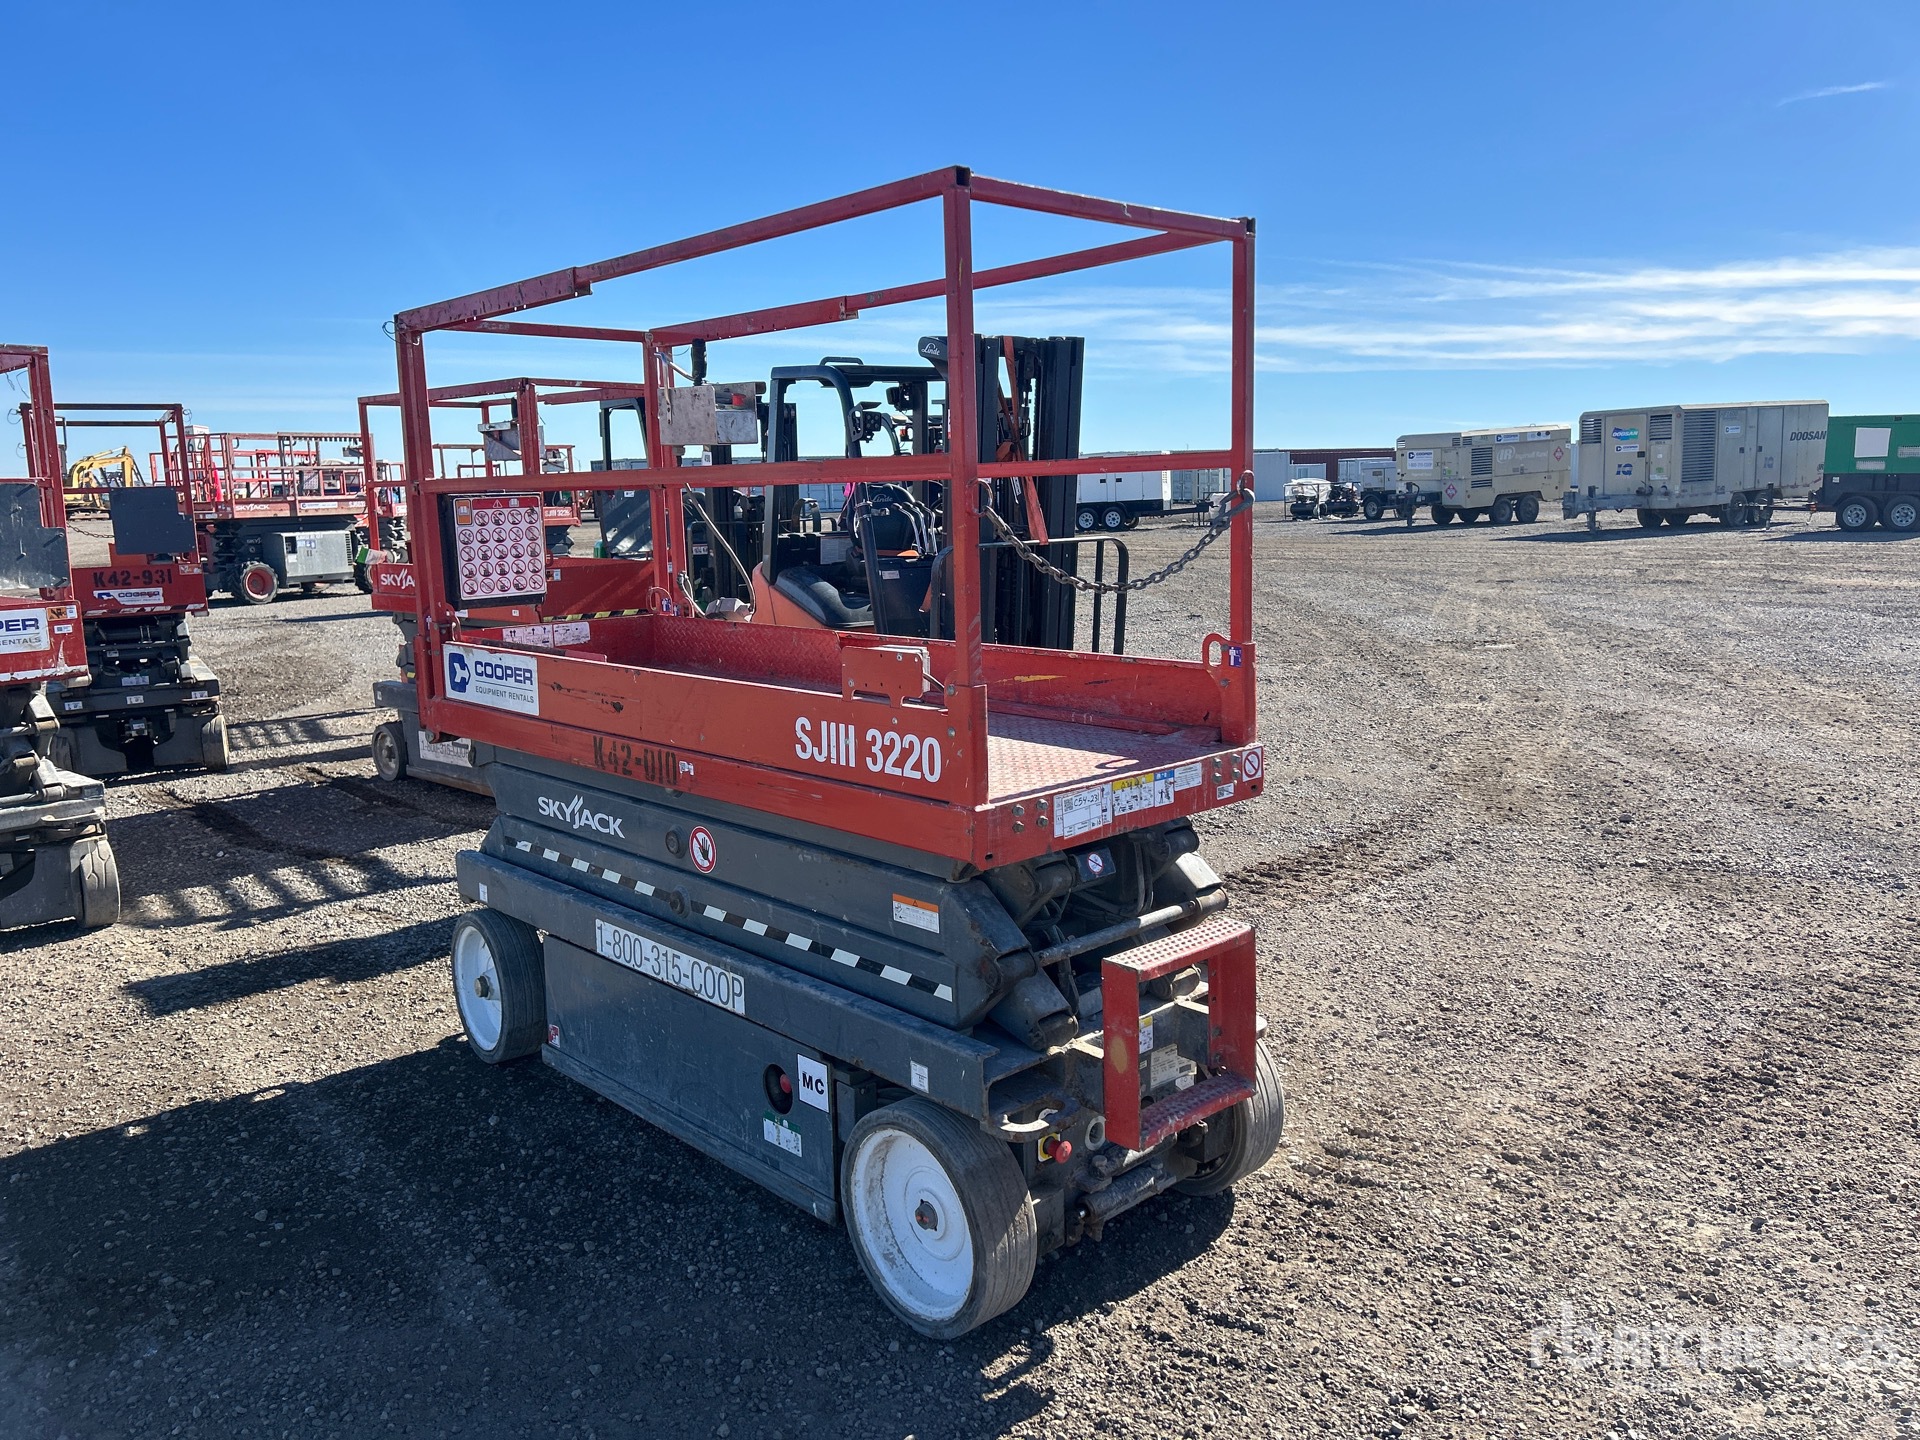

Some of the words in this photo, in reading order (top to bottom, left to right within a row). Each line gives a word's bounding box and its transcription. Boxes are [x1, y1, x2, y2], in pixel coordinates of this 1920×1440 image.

[921, 342, 940, 355] Linde
[1789, 430, 1827, 441] DOOSAN
[235, 503, 270, 511] SKYJACK
[0, 617, 40, 632] ER
[0, 637, 41, 646] ENTALS
[474, 660, 534, 686] COOPER
[475, 685, 507, 699] EQUIPMENT
[508, 692, 535, 704] RENTALS
[865, 728, 942, 783] 3220
[537, 794, 625, 839] SKYJACK
[597, 923, 743, 1010] 1-800-315-COOP
[802, 1072, 825, 1095] MC
